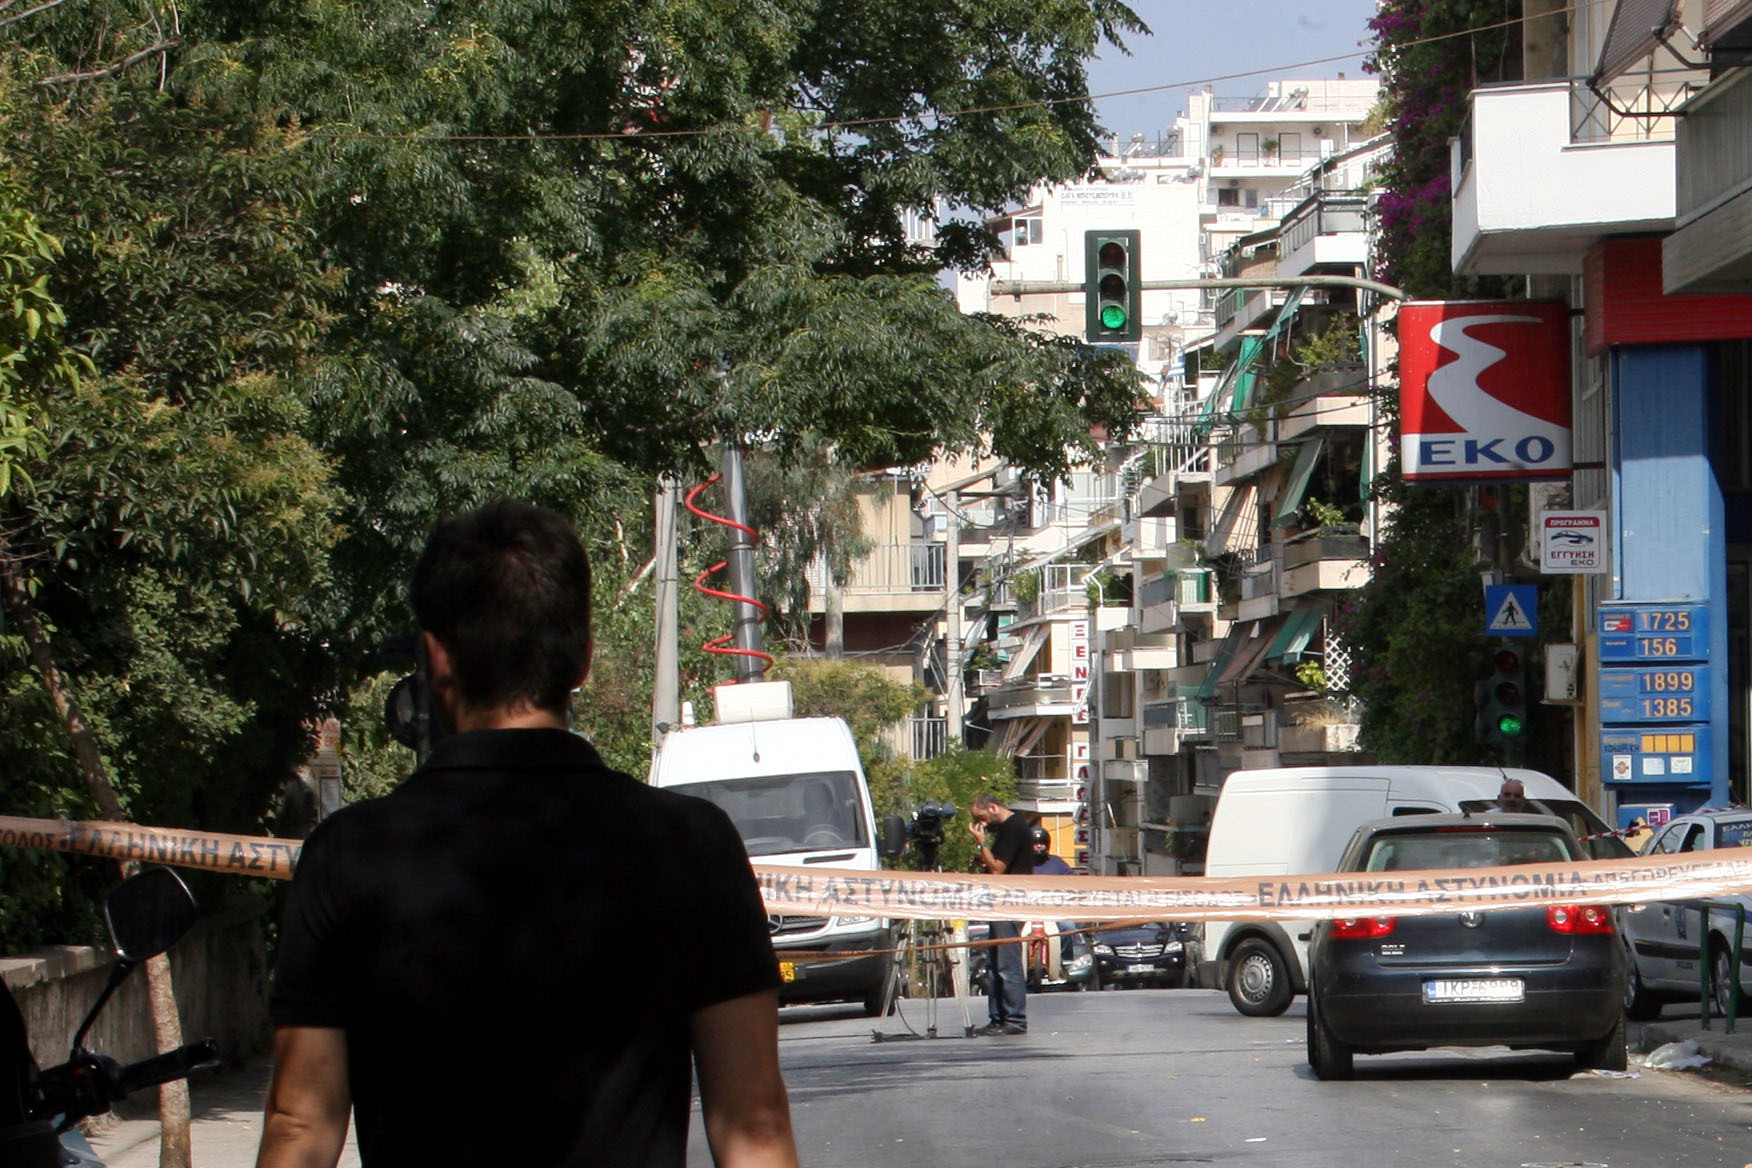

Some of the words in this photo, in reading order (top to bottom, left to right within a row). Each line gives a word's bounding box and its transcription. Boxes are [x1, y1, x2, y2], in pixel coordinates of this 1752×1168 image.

[1420, 435, 1555, 466] EKO
[1551, 551, 1595, 559] ΕΓΓΥΗΣΗ
[1640, 611, 1691, 631] 1725
[1641, 638, 1677, 656] 156
[1643, 671, 1694, 692] 1899
[1642, 697, 1692, 718] 1385
[1077, 745, 1089, 876] ΓΛΩΣΣΕ
